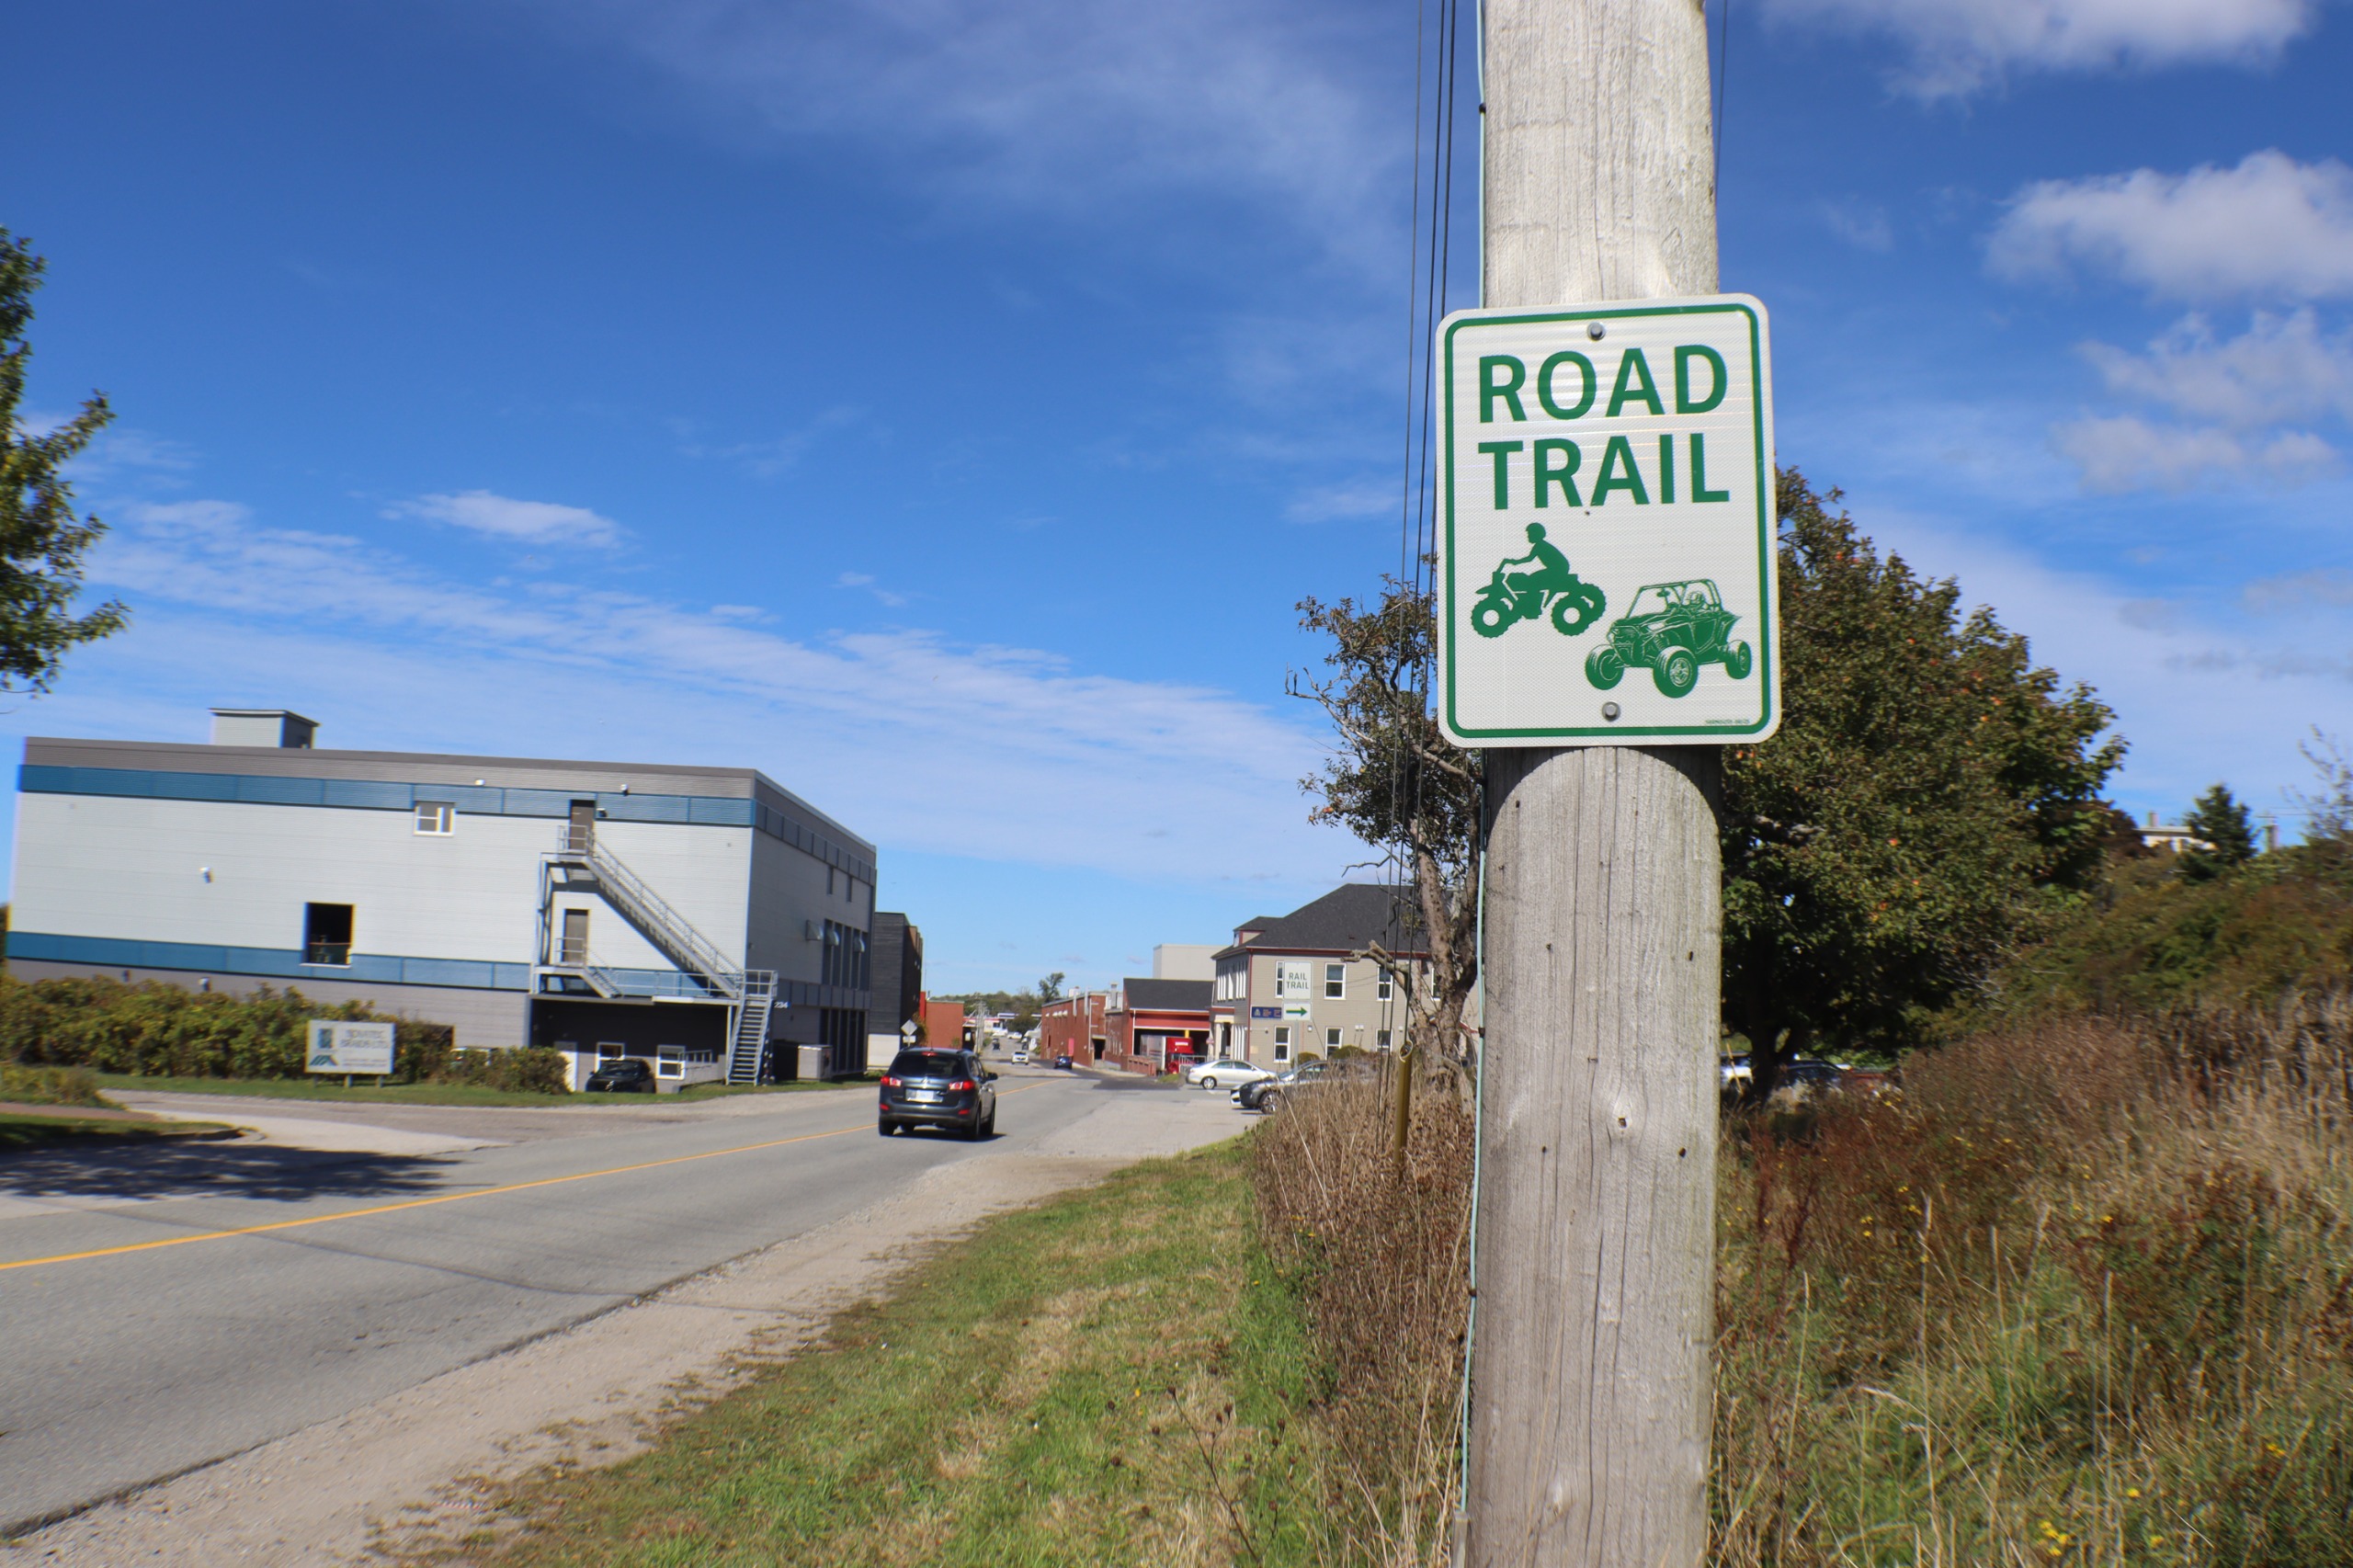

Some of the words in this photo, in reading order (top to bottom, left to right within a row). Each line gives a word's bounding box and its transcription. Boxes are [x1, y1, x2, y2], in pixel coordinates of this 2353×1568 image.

[1479, 344, 1728, 423] ROAD
[1478, 433, 1730, 510] TRAIL
[1286, 981, 1310, 990] TRAIL
[1289, 971, 1307, 981] RAIL
